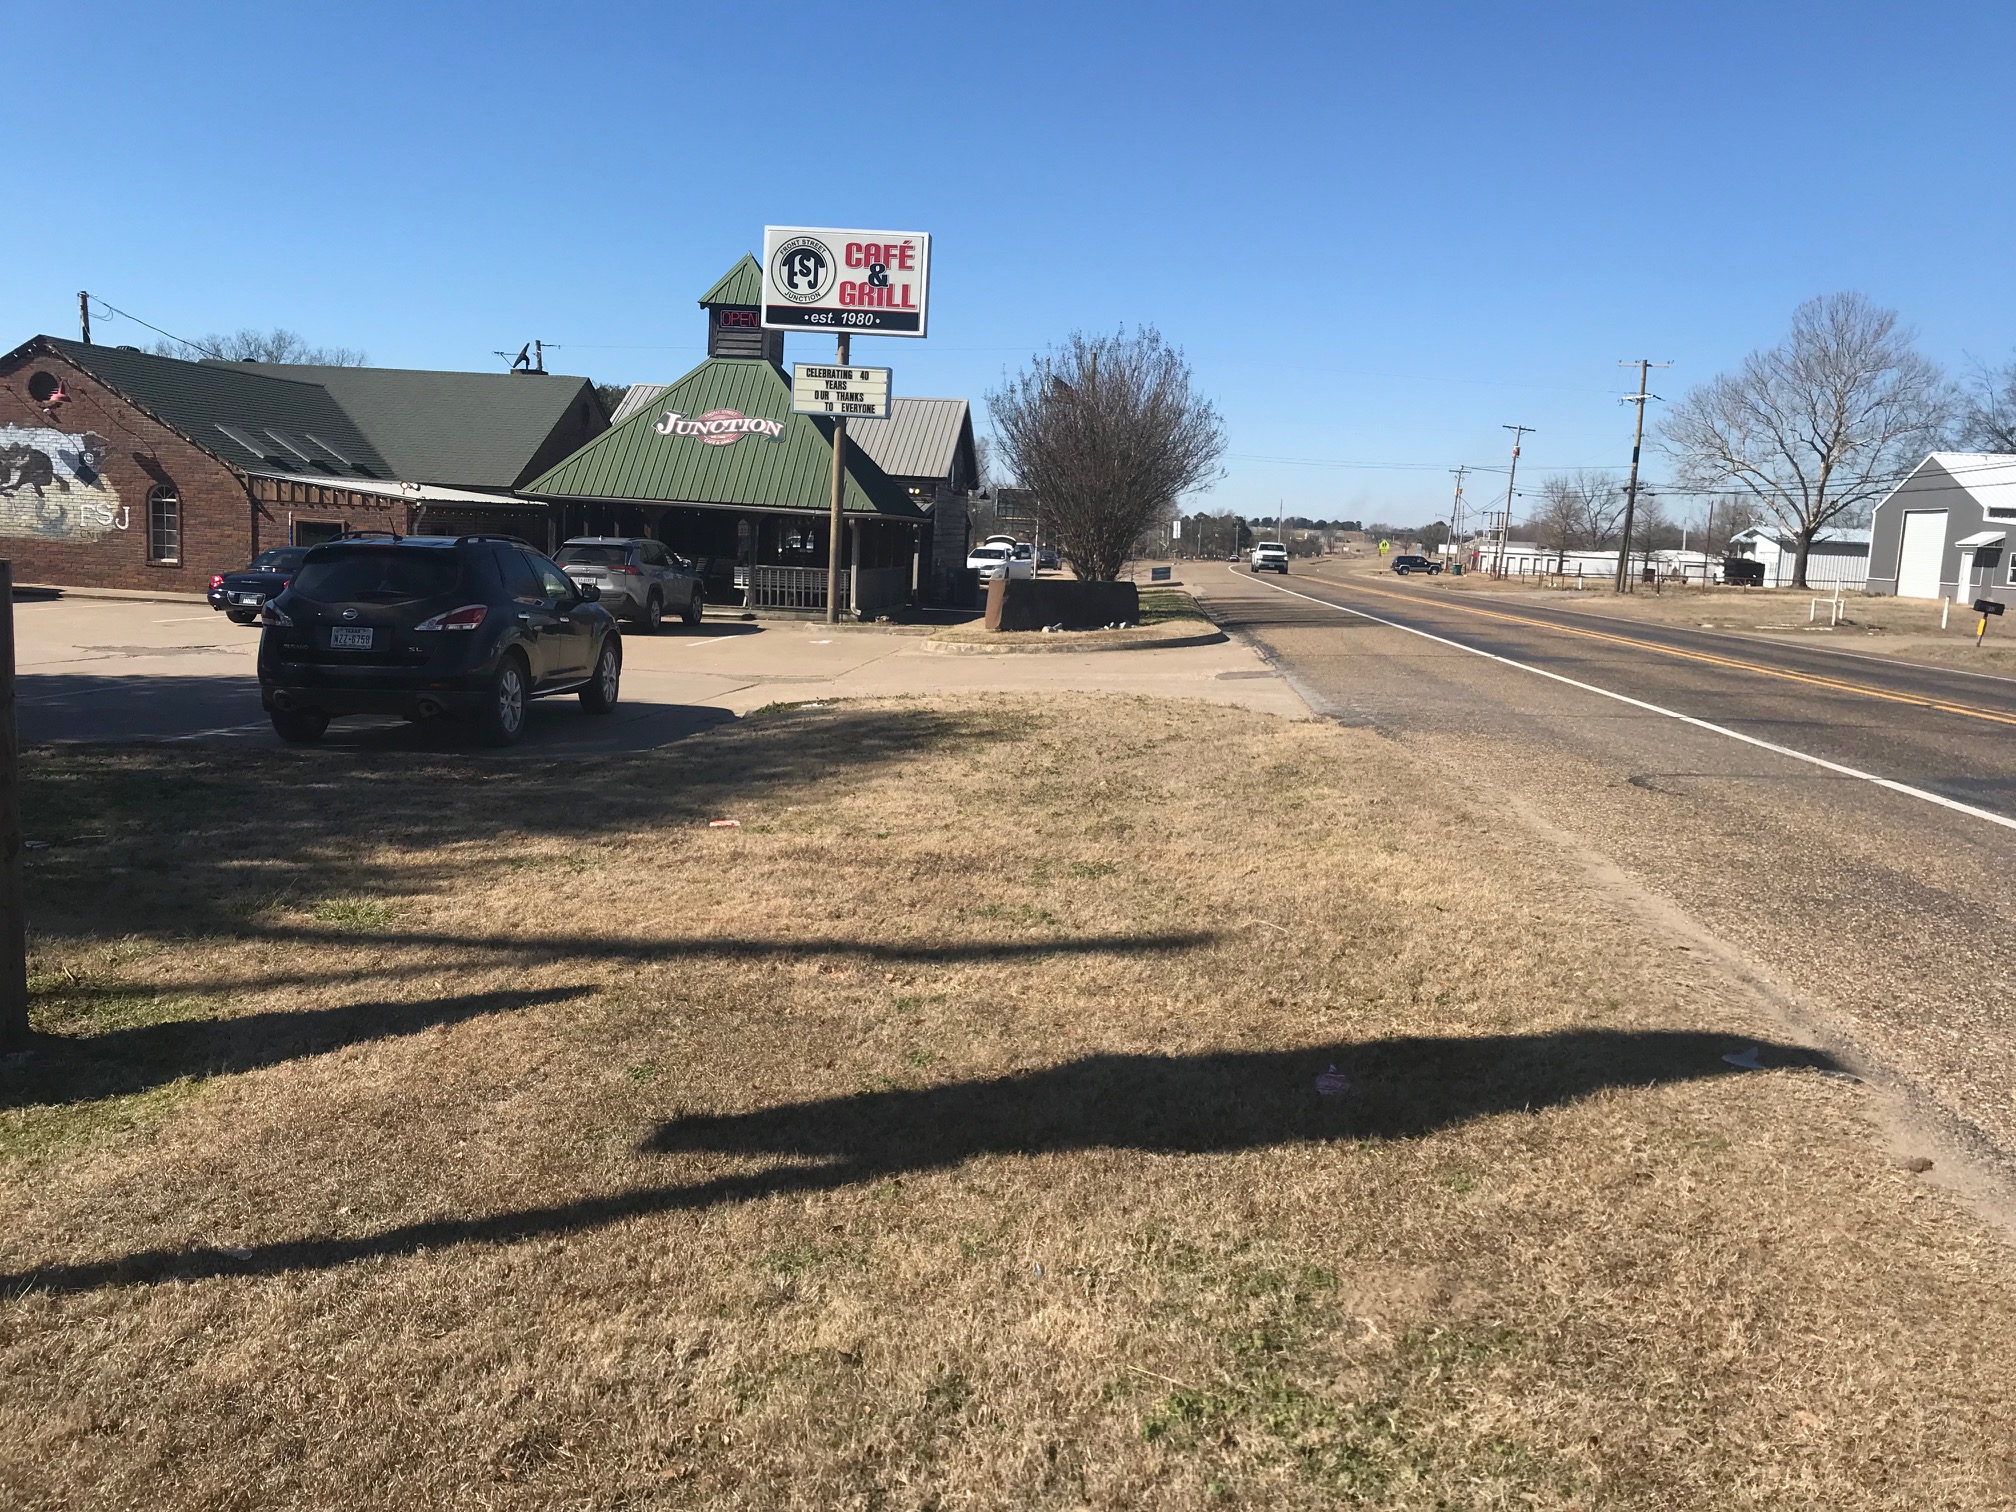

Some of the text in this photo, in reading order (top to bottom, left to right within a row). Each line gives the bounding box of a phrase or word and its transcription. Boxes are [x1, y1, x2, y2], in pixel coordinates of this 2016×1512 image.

[779, 239, 827, 255] FRONT STREET
[844, 240, 916, 271] CAFÉ
[868, 263, 889, 288] &
[784, 291, 821, 302] JUNCTION
[839, 280, 917, 309] GRILL
[722, 311, 758, 327] OPEN
[810, 312, 874, 326] est. 1980
[806, 367, 869, 380] CELEBRATING 40
[825, 380, 847, 390] YEARS
[814, 390, 864, 402] OUR THANKS
[824, 402, 875, 414] TO EVERYONE
[656, 411, 784, 437] JUNCTION
[80, 504, 131, 530] FSJ
